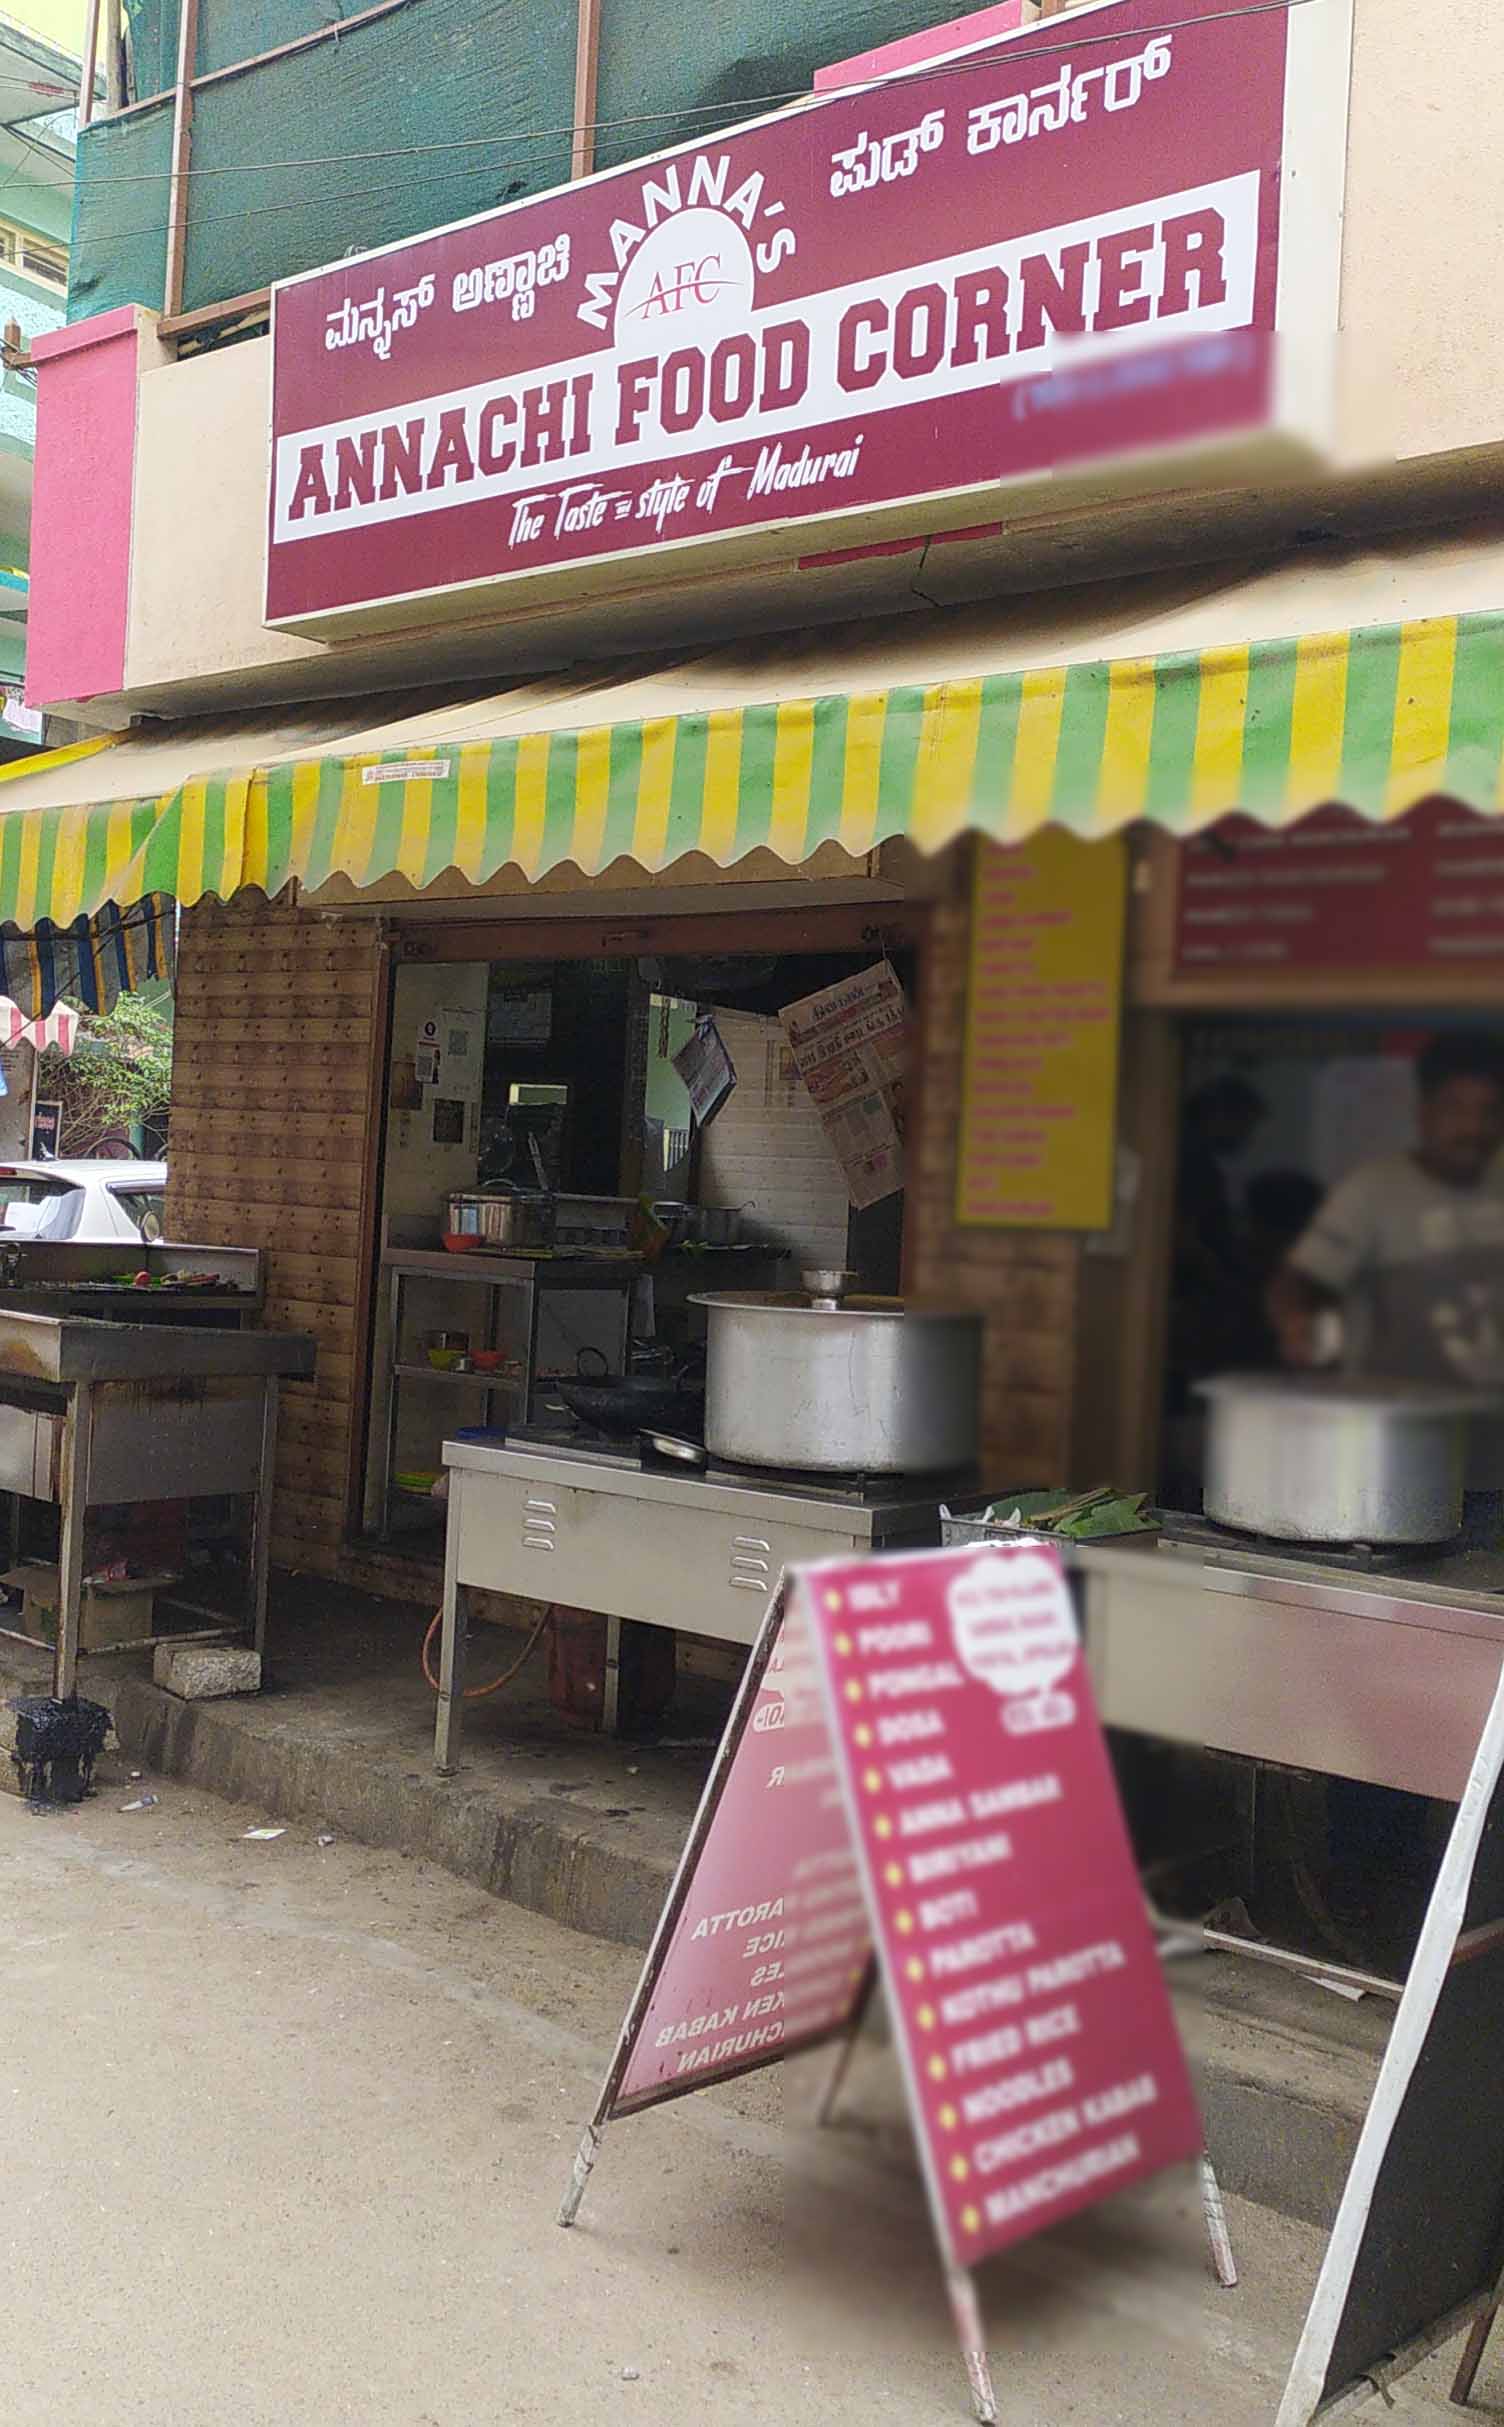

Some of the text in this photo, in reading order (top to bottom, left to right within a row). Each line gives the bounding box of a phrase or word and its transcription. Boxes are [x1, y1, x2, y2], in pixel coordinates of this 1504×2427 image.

[967, 33, 1172, 156] ಕಾರ್ನರ್
[576, 154, 797, 331] MANNA'S
[641, 252, 721, 320] AFC
[287, 372, 595, 522] ANNACHI
[614, 318, 811, 446] FOOD
[836, 206, 1227, 395] CORNER
[508, 433, 865, 550] The Taste style of Madurai
